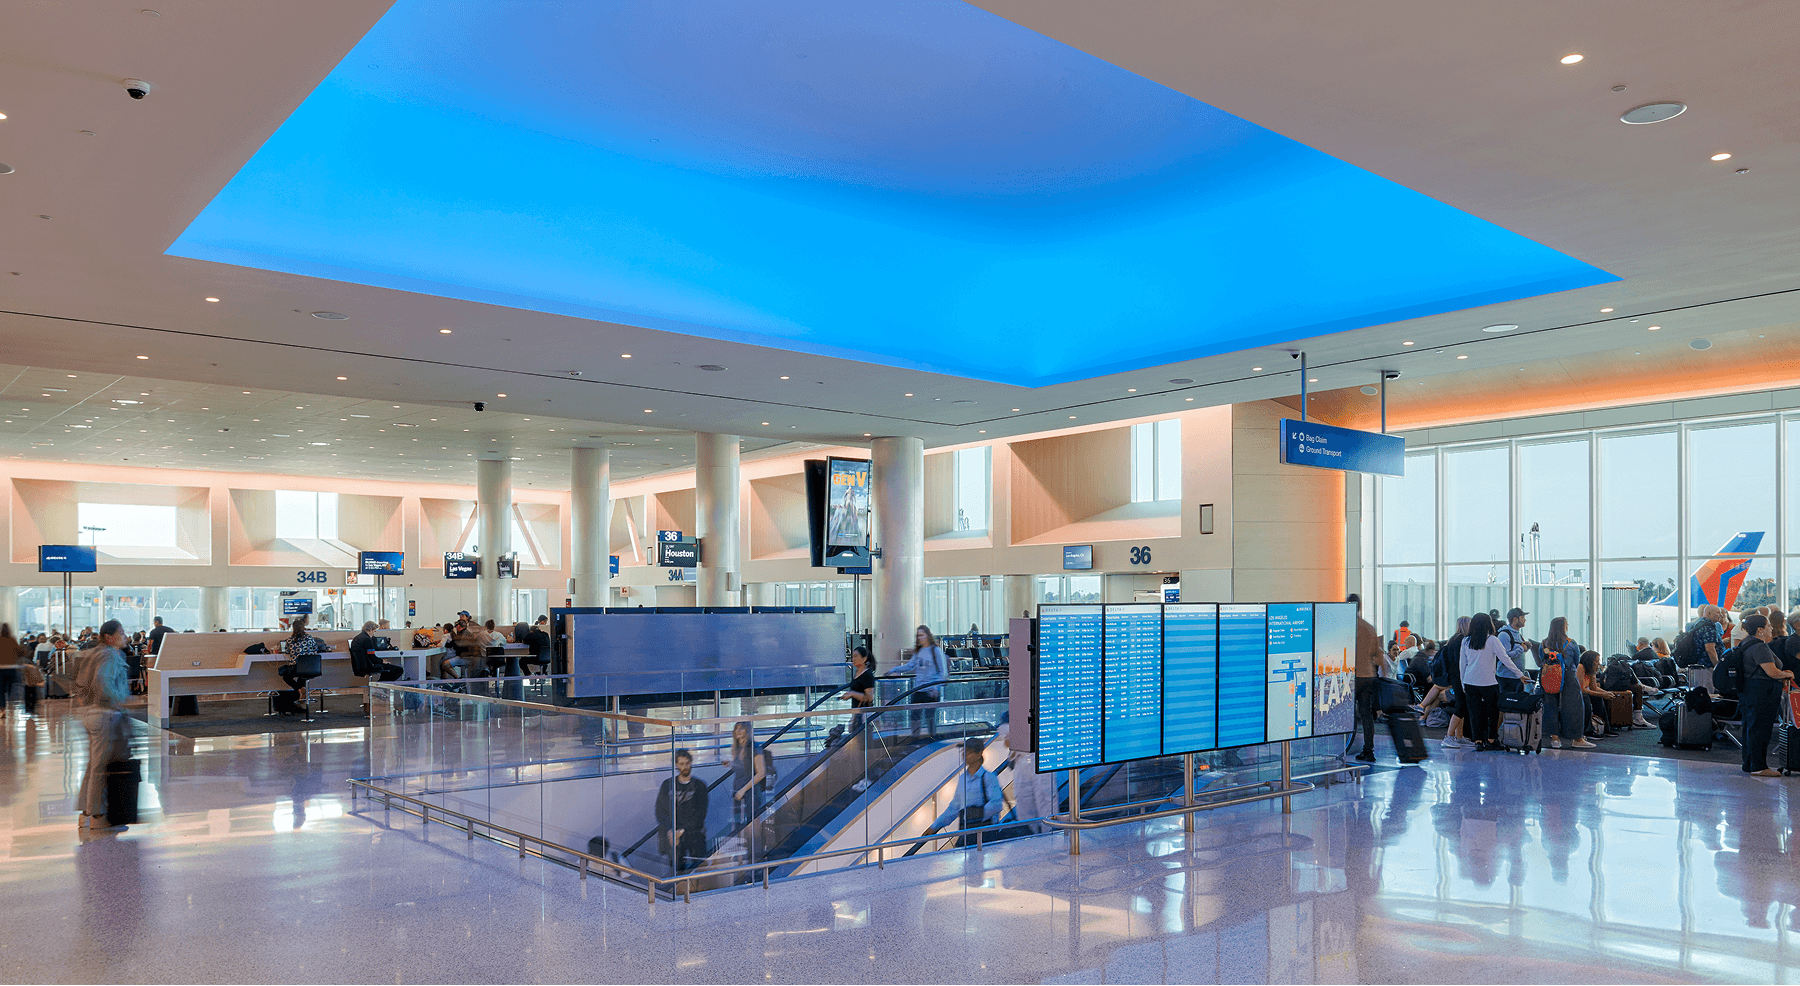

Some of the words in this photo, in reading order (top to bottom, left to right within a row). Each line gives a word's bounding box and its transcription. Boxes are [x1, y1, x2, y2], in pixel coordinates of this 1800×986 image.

[1306, 435, 1315, 443] Bag
[1315, 436, 1327, 444] Claim
[1306, 446, 1322, 454] Ground
[1322, 448, 1342, 457] Transport
[856, 471, 867, 487] V
[664, 531, 678, 541] 36
[446, 552, 464, 560] 34B
[665, 549, 694, 557] Houston
[1129, 546, 1151, 565] 36
[297, 571, 328, 583] 34B
[668, 569, 683, 581] 34A
[1320, 671, 1353, 716] LAX
